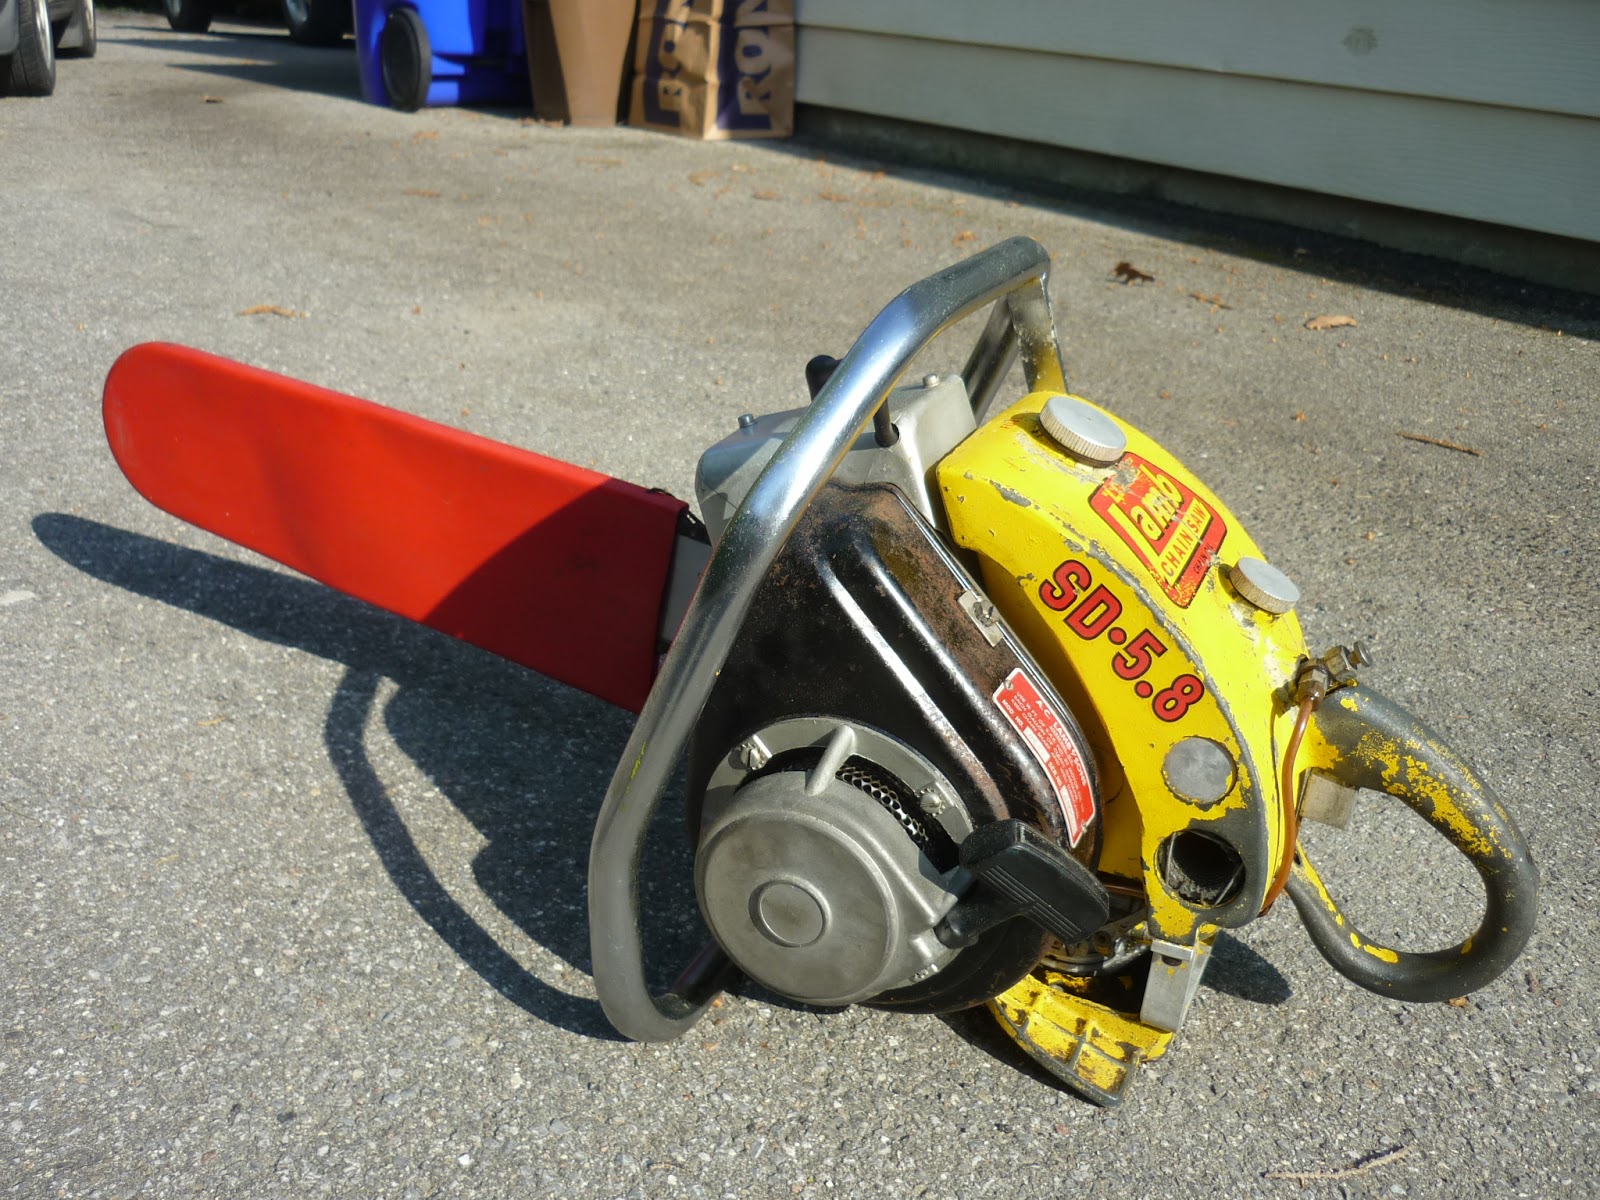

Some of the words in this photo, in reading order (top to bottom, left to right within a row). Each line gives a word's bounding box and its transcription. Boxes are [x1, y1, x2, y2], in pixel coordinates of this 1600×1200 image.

[1160, 528, 1194, 577] CHAIN
[1186, 502, 1208, 535] SAW
[1014, 715, 1025, 727] NO.
[1025, 711, 1046, 735] GALLON
[1052, 720, 1073, 751] LAMB
[1074, 757, 1087, 786] SONS
